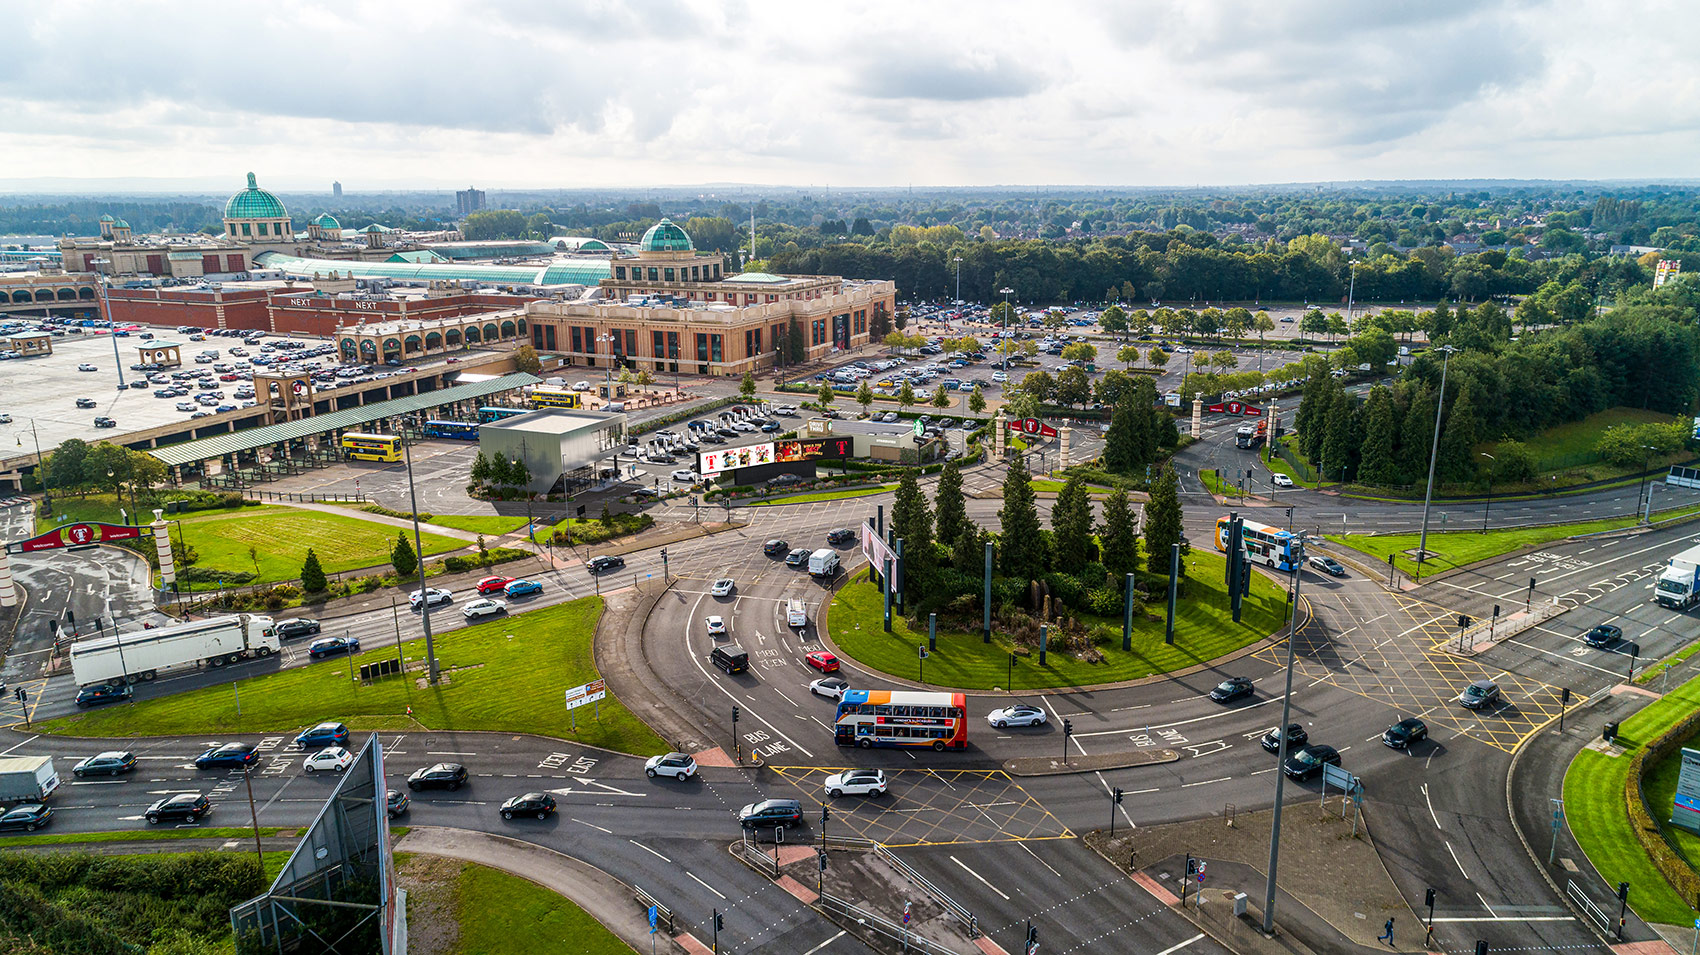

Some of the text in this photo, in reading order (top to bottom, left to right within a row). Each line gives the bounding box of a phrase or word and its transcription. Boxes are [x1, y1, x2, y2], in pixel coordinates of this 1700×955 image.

[290, 298, 311, 306] NEXT
[355, 301, 377, 310] NEXT
[743, 730, 770, 744] BUS
[1129, 734, 1157, 747] BUS
[1156, 728, 1190, 744] LANE
[756, 741, 791, 757] LANE
[261, 758, 295, 775] EAST
[566, 756, 599, 774] EAST
